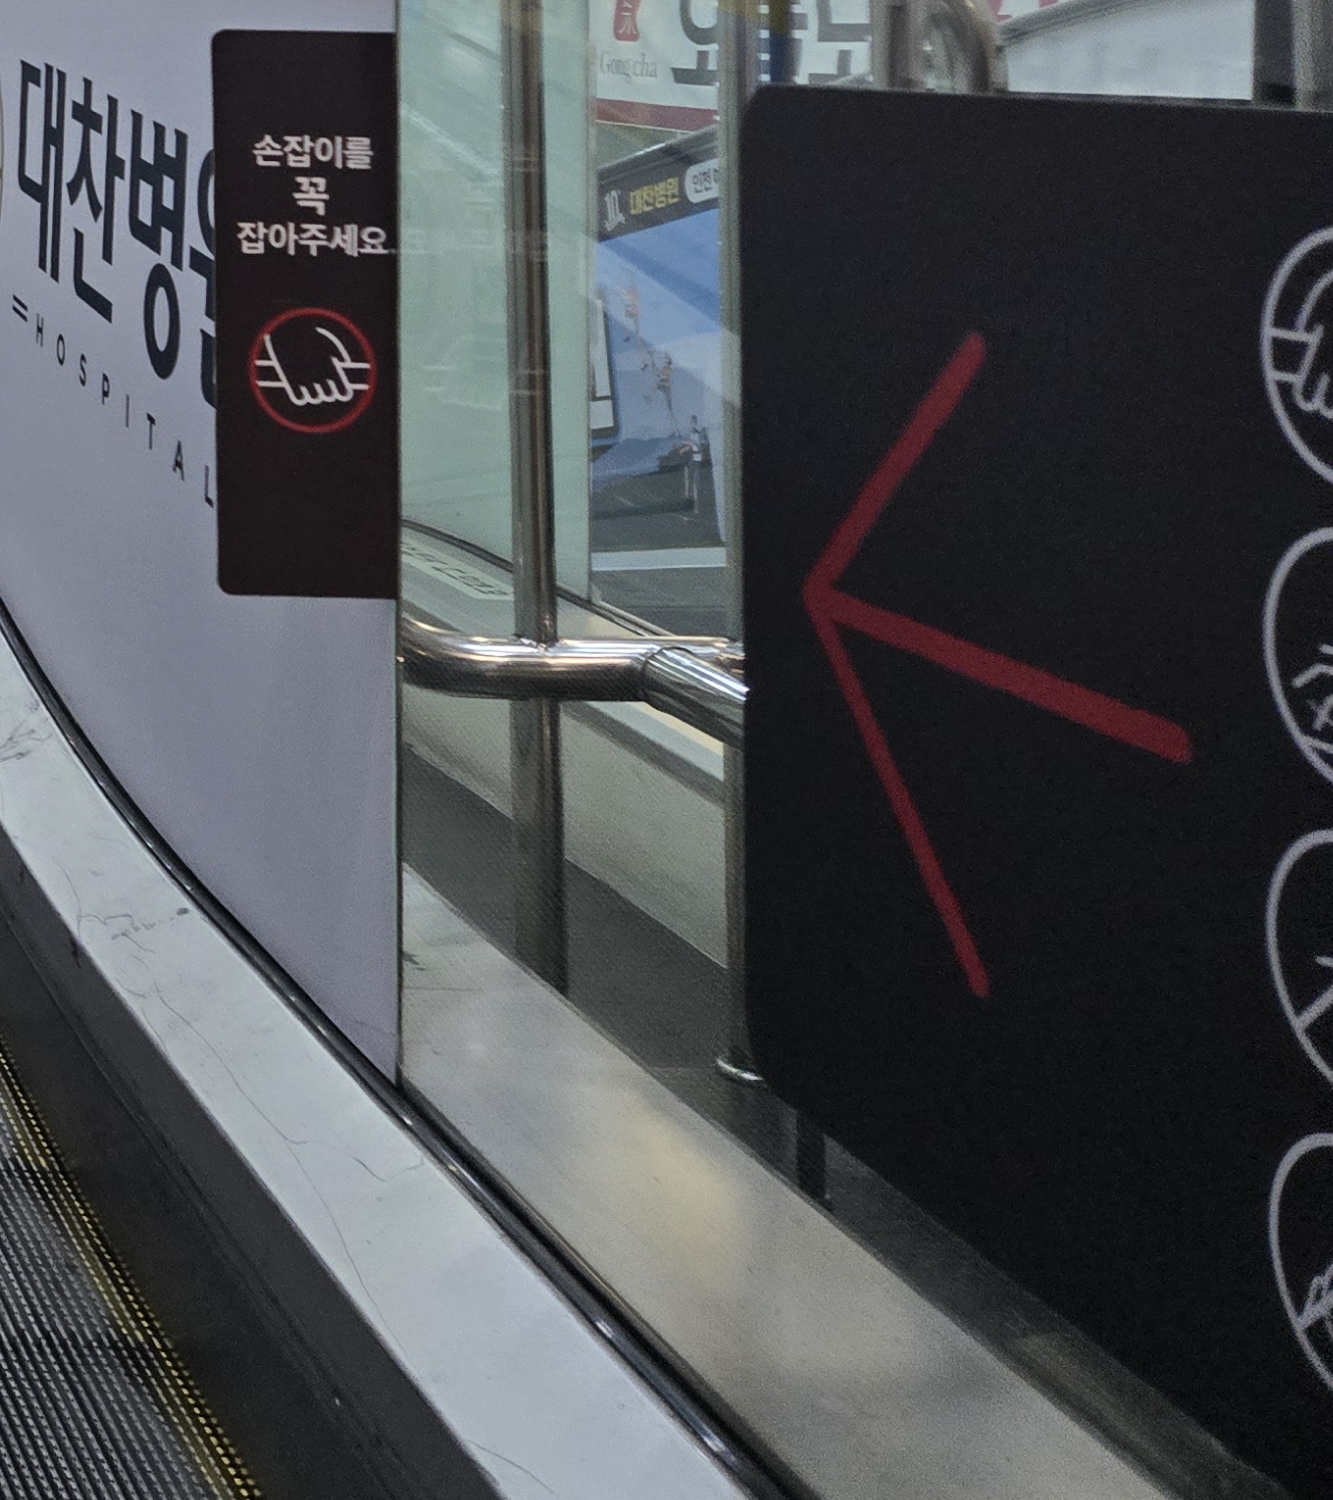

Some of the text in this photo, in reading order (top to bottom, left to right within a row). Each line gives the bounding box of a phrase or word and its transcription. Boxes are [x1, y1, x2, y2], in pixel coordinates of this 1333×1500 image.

[252, 134, 375, 170] 손잡이를
[293, 174, 331, 216] 꼭
[18, 59, 216, 409] 대찬병
[236, 222, 397, 258] 잡아주세요.
[36, 311, 215, 508] HOSPITAL
